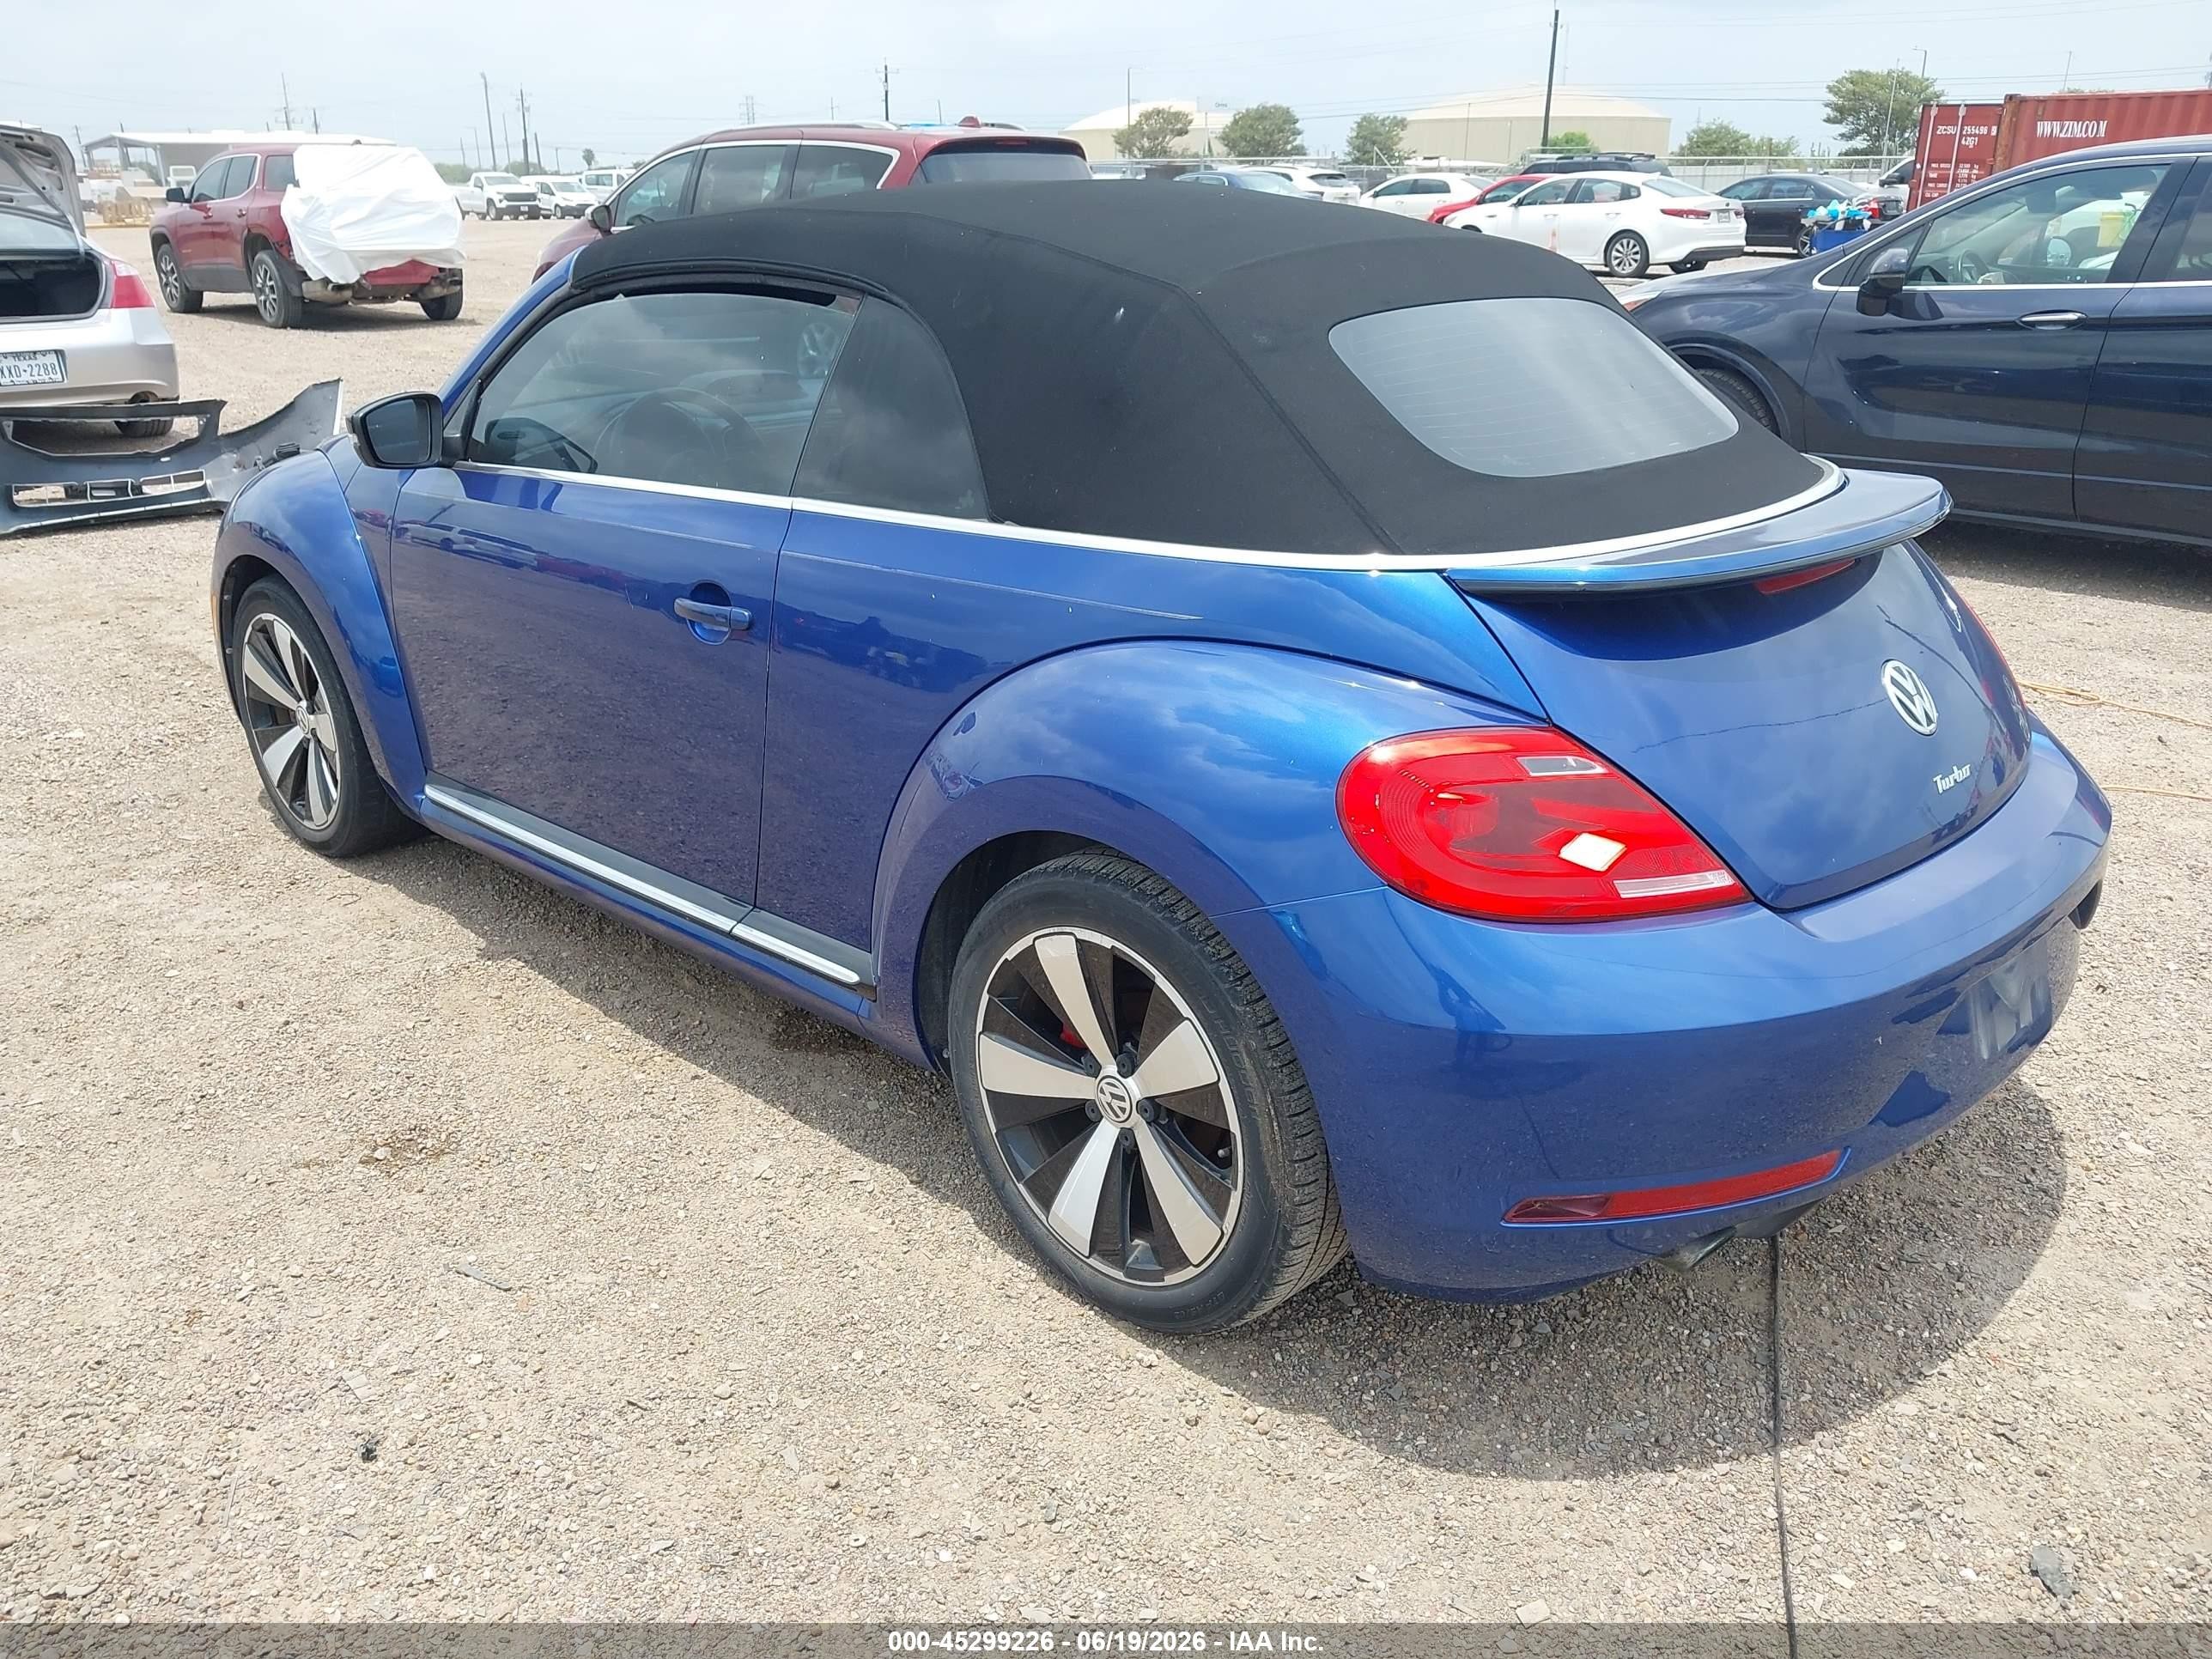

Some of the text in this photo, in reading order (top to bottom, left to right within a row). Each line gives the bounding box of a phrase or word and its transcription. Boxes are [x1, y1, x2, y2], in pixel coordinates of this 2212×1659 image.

[1936, 125, 1957, 135] ZCSU
[1962, 125, 1989, 135] 255496
[1961, 137, 1978, 146] 42G1
[1932, 763, 1972, 794] Turbo
